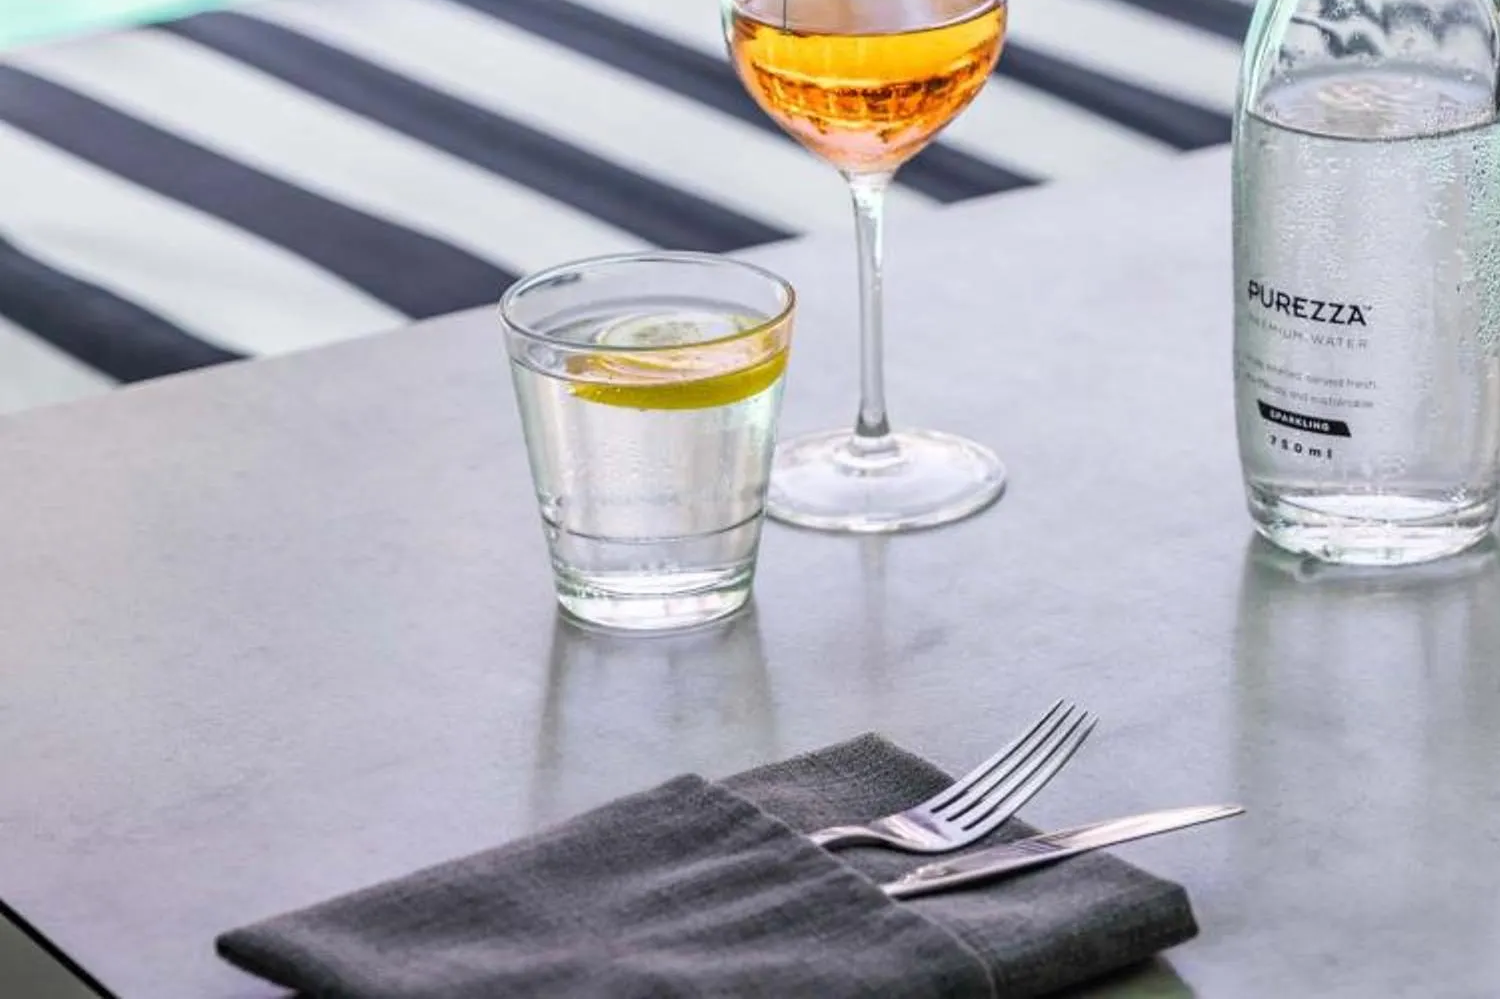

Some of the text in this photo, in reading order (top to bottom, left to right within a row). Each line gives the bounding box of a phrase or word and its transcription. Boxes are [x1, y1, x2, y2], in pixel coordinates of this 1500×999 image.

[1247, 279, 1367, 326] PUREZZA
[1249, 312, 1368, 349] EMIUM WATER
[1268, 408, 1331, 433] SPARKLING
[1269, 434, 1333, 460] 750ml
